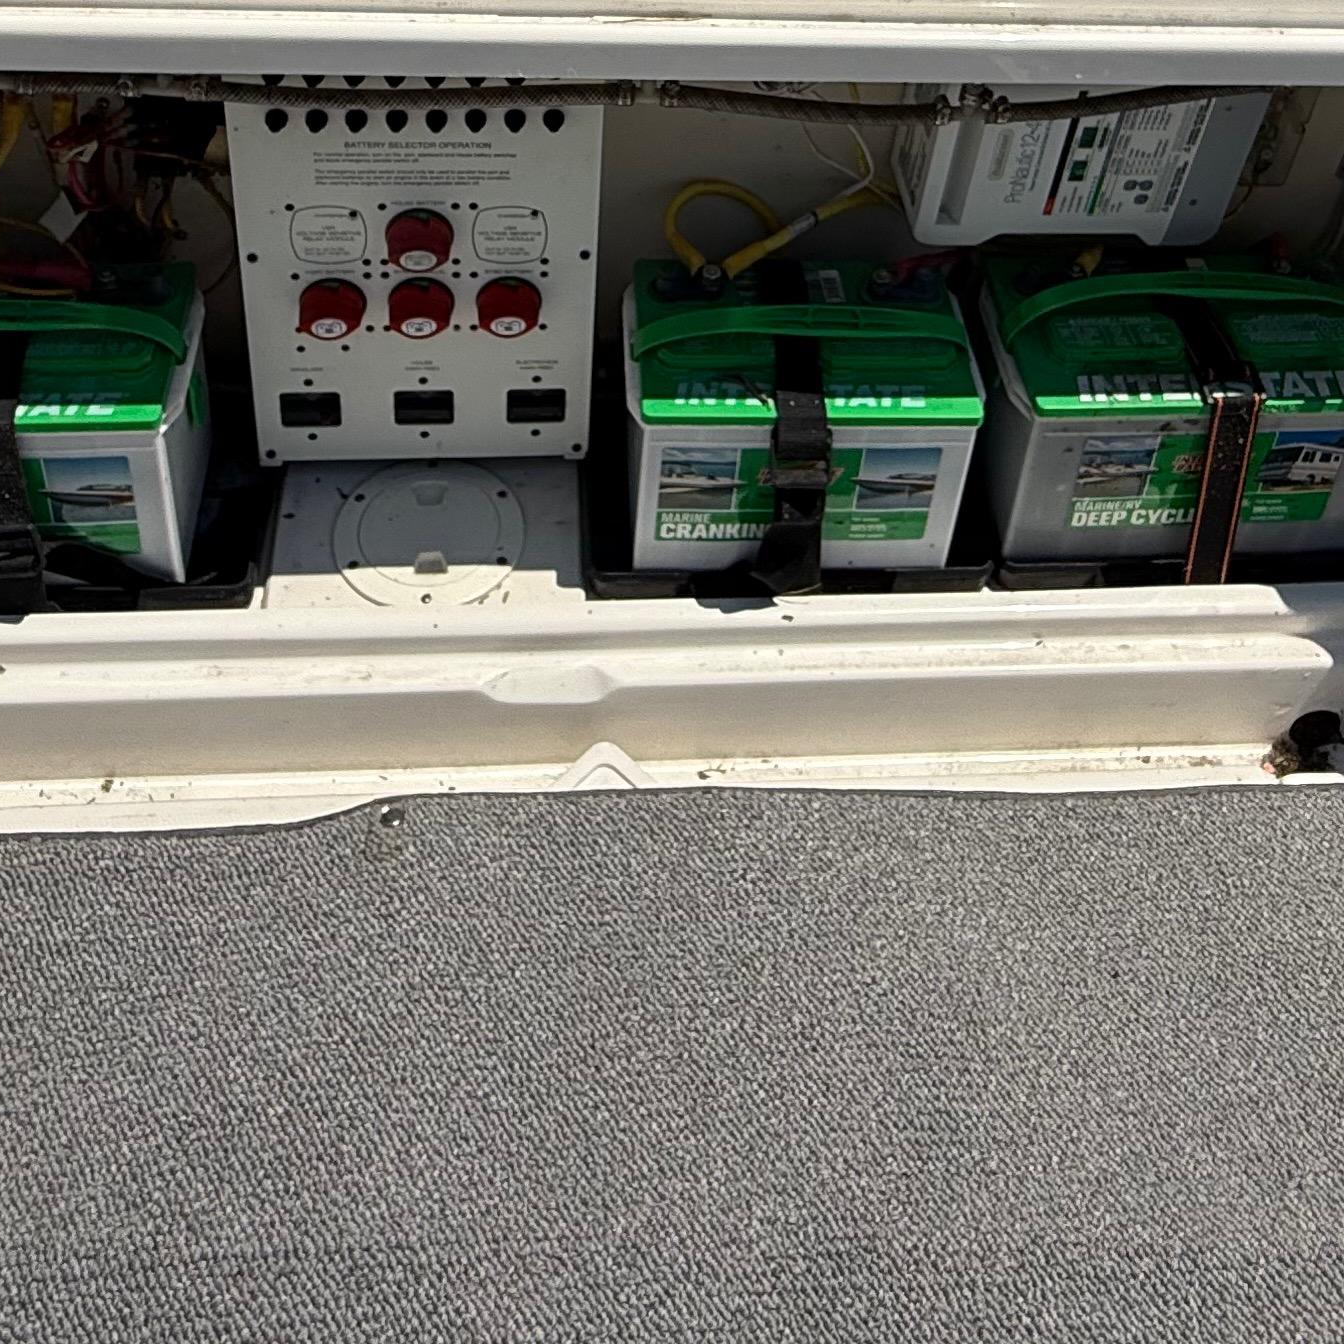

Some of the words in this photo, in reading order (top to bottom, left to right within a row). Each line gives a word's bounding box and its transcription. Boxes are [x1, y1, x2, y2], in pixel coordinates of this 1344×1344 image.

[344, 141, 386, 149] BATTERY
[388, 141, 437, 149] SELECTOR
[438, 141, 492, 149] OPERATION
[674, 382, 927, 407] INTETATE
[1074, 499, 1142, 512] MARINE/RV
[661, 512, 712, 524] MARINE
[1071, 510, 1128, 527] DEEP
[660, 522, 771, 540] CRANKIN
